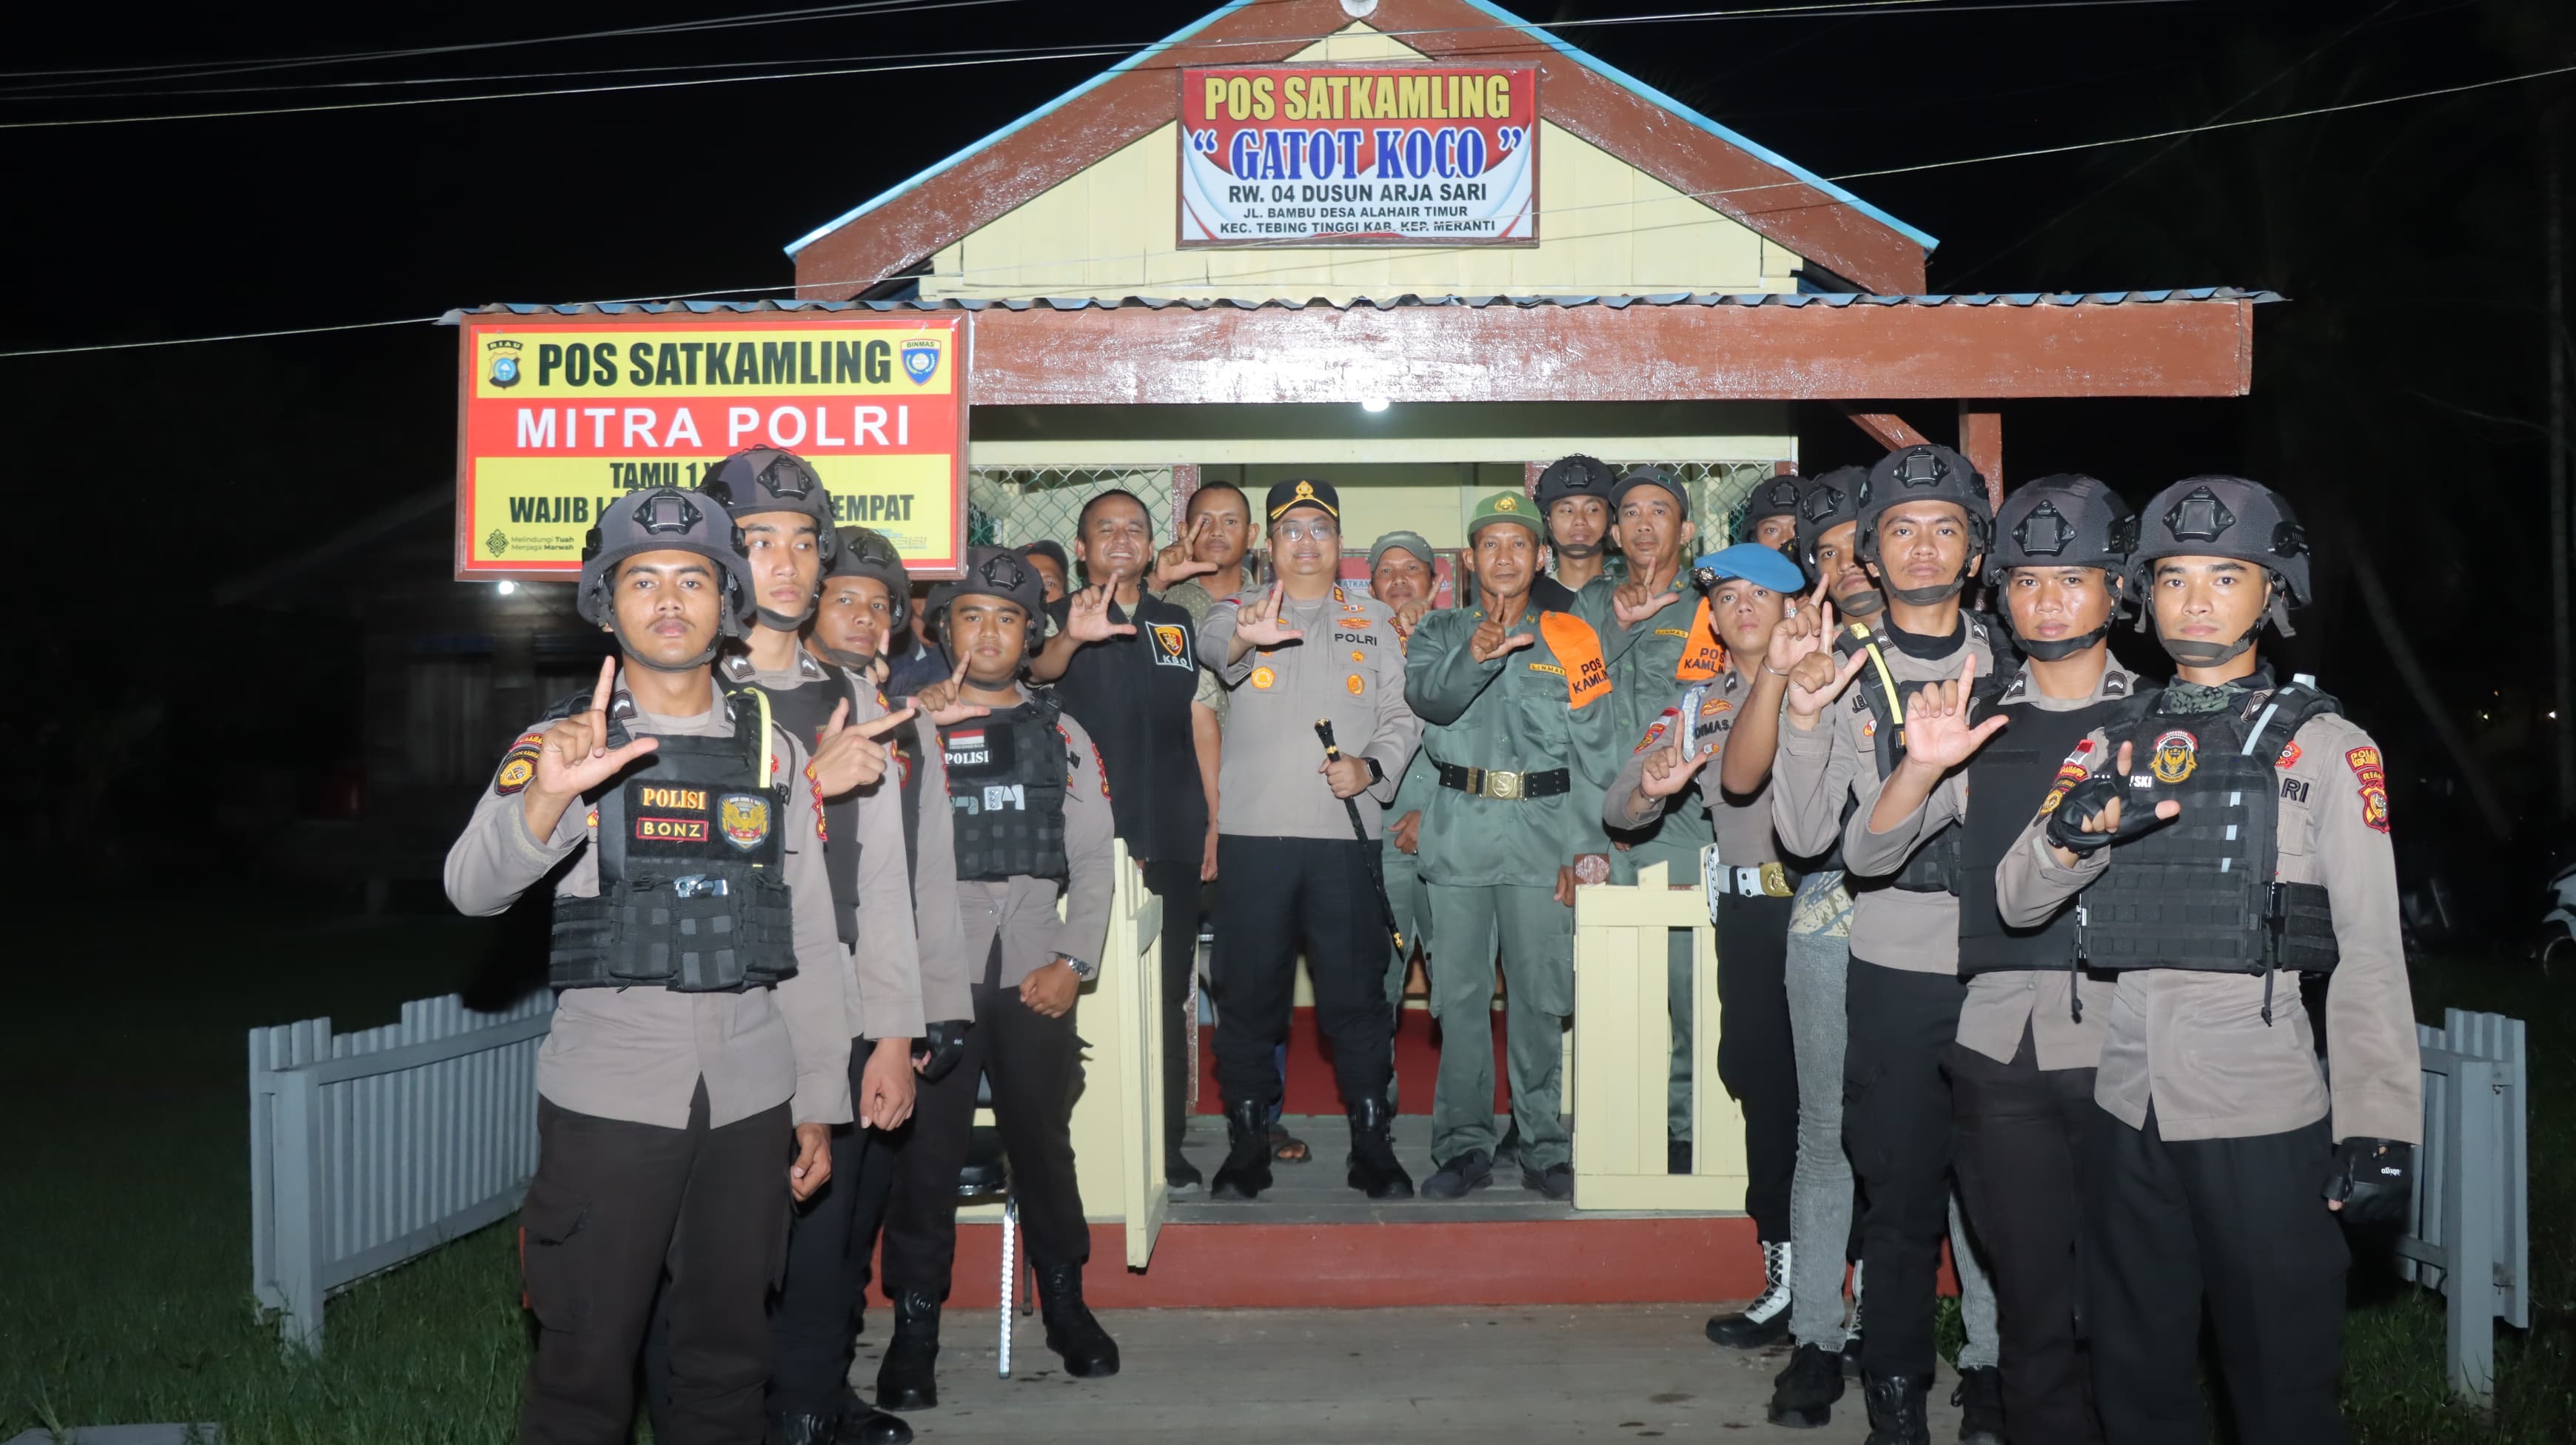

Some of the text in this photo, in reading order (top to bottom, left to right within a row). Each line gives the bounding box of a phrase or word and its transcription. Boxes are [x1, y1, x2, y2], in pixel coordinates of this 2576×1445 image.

[1204, 74, 1511, 121] POS SATKAMLING
[1231, 129, 1363, 181] GATOT
[1375, 127, 1486, 180] KOCO
[1229, 183, 1487, 204] RW. 04 DUSUN ARJA SARI
[1244, 205, 1468, 219] JL. BAMBU DESA ALAHAIR TIMUR
[1220, 224, 1252, 234] KEC.
[1257, 223, 1307, 234] TEBING
[1311, 222, 1360, 233] TINGGI
[1364, 221, 1396, 232] KAB.
[1434, 220, 1495, 232] MERANTI
[489, 341, 521, 349] RIAU
[538, 339, 892, 386] POS SATKAMLING
[516, 405, 909, 449] MITRA POLRI
[609, 462, 680, 489] TAMU
[685, 463, 697, 487] 1
[509, 497, 589, 523] WAJIB
[1335, 633, 1378, 646] POLRI
[1162, 654, 1188, 666] KBO
[1700, 647, 1725, 664] POS
[1532, 664, 1564, 675] LINMAS
[1580, 657, 1603, 676] POS
[1694, 719, 1730, 740] DIMAS
[945, 750, 990, 765] POLISI
[642, 787, 707, 810] POLISI
[643, 821, 702, 837] BONZ
